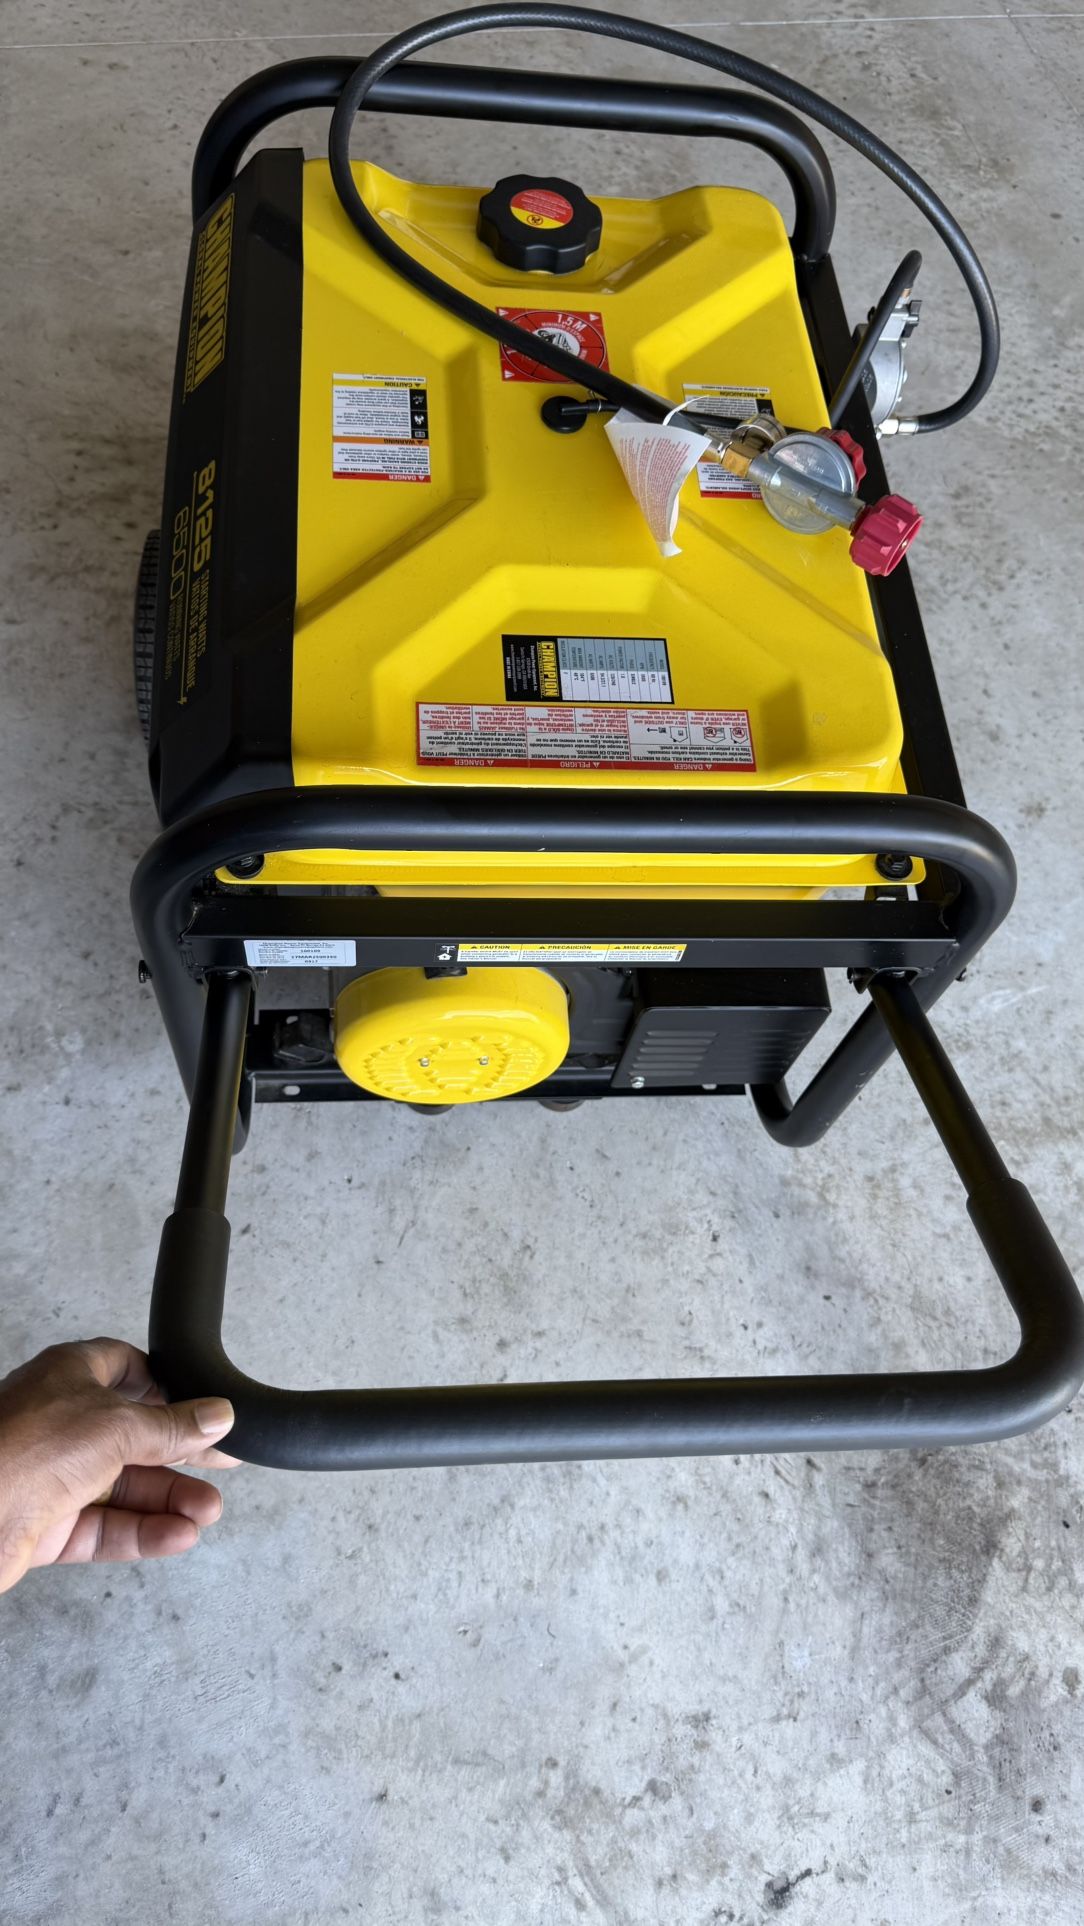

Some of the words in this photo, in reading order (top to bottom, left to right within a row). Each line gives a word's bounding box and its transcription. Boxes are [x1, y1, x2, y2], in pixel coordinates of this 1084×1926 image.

[193, 195, 235, 391] CHAMPION
[170, 507, 189, 599] 6500
[193, 460, 216, 573] 8125
[540, 642, 559, 697] CHAMPION
